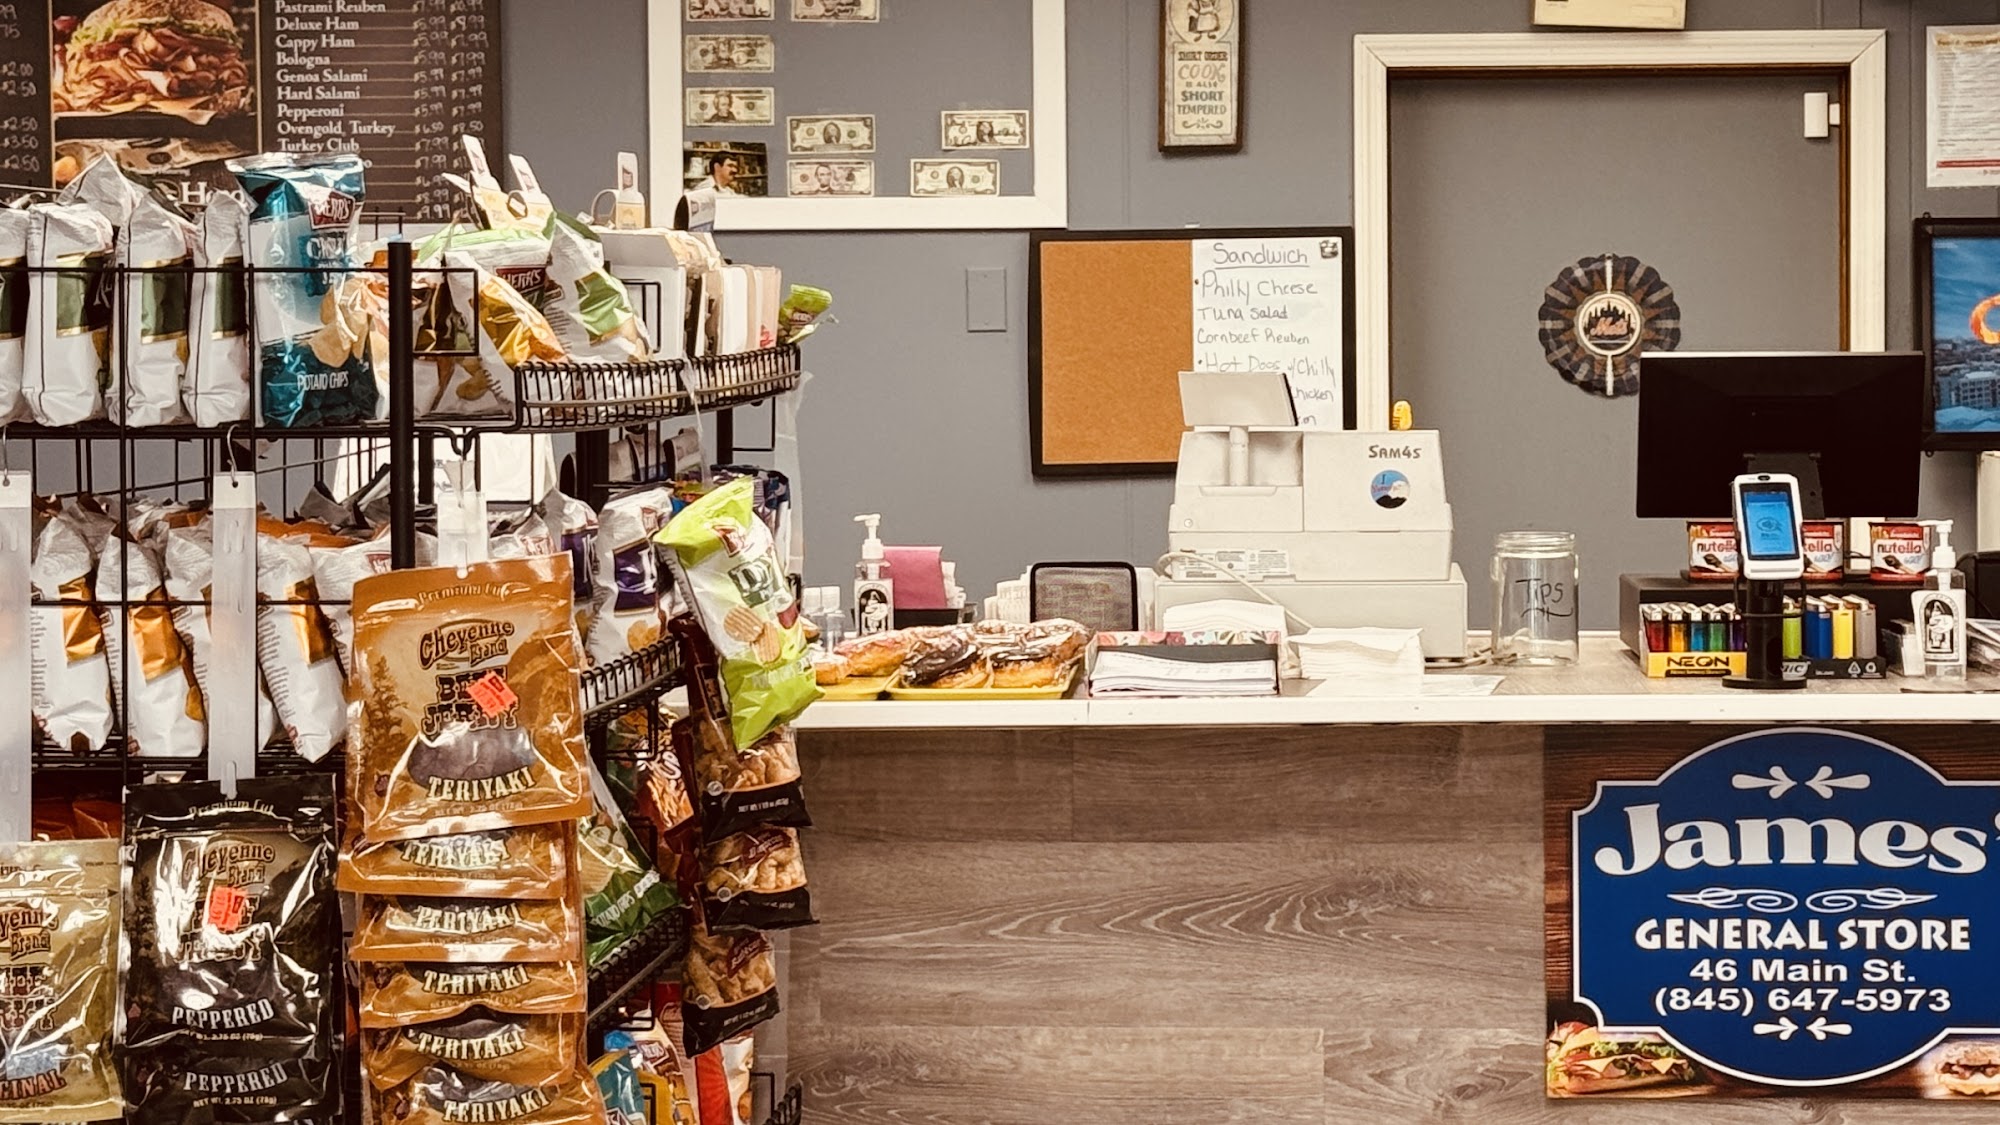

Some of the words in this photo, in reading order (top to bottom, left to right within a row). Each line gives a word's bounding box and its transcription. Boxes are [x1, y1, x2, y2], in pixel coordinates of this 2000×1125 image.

[275, 0, 333, 13] Pastrami
[336, 0, 386, 13] Reuben
[275, 16, 323, 31] Deluxe
[326, 16, 360, 31] Ham
[275, 33, 319, 53] Cappy
[321, 33, 355, 48] Ham
[276, 51, 331, 70] Bologna
[276, 68, 319, 83] Genoa
[322, 68, 368, 82] Salami
[1178, 63, 1226, 83] COOK
[277, 85, 313, 100] Hard
[315, 85, 361, 100] Salami
[1181, 90, 1224, 102] SHORT
[277, 103, 344, 122] Pepperoni
[1176, 104, 1227, 115] TEMPERED
[349, 120, 396, 138] Turkey
[277, 138, 324, 153] Turkey
[326, 138, 360, 152] Club
[1213, 242, 1308, 265] Sandwich
[1201, 269, 1250, 306] Philly
[1257, 279, 1318, 297] Cheese
[1197, 306, 1244, 321] Tuna
[1197, 327, 1260, 345] Cornbeef
[1265, 327, 1310, 345] Reuben
[1205, 352, 1242, 373] Hot
[296, 373, 328, 391] POTATO
[329, 370, 350, 389] CHIPS
[1291, 386, 1334, 402] hicken
[1803, 540, 1833, 553] tella
[1877, 541, 1922, 553] nutella
[419, 621, 515, 670] Cheyenne
[469, 638, 508, 667] Brand
[1666, 656, 1730, 667] NEON
[436, 666, 507, 703] BE
[427, 766, 537, 802] TERIYAKI
[401, 838, 512, 869] TERIYAKI
[415, 898, 522, 935] TERIYAKI
[11, 929, 51, 961] Brand
[1634, 918, 1828, 950] GENERAL
[1838, 918, 1971, 951] STORE
[422, 963, 531, 995] TERIYAKI
[1689, 959, 1738, 982] 46
[1752, 959, 1848, 982] Main
[1862, 959, 1916, 982] St.
[1655, 988, 1754, 1017] (845)
[1767, 988, 1951, 1012] 647-5973
[172, 998, 275, 1029] PEPPERED
[418, 1029, 525, 1060] TERIYAKI
[183, 1062, 288, 1093] PEPPERED
[443, 1088, 551, 1123] TERIYAKI
